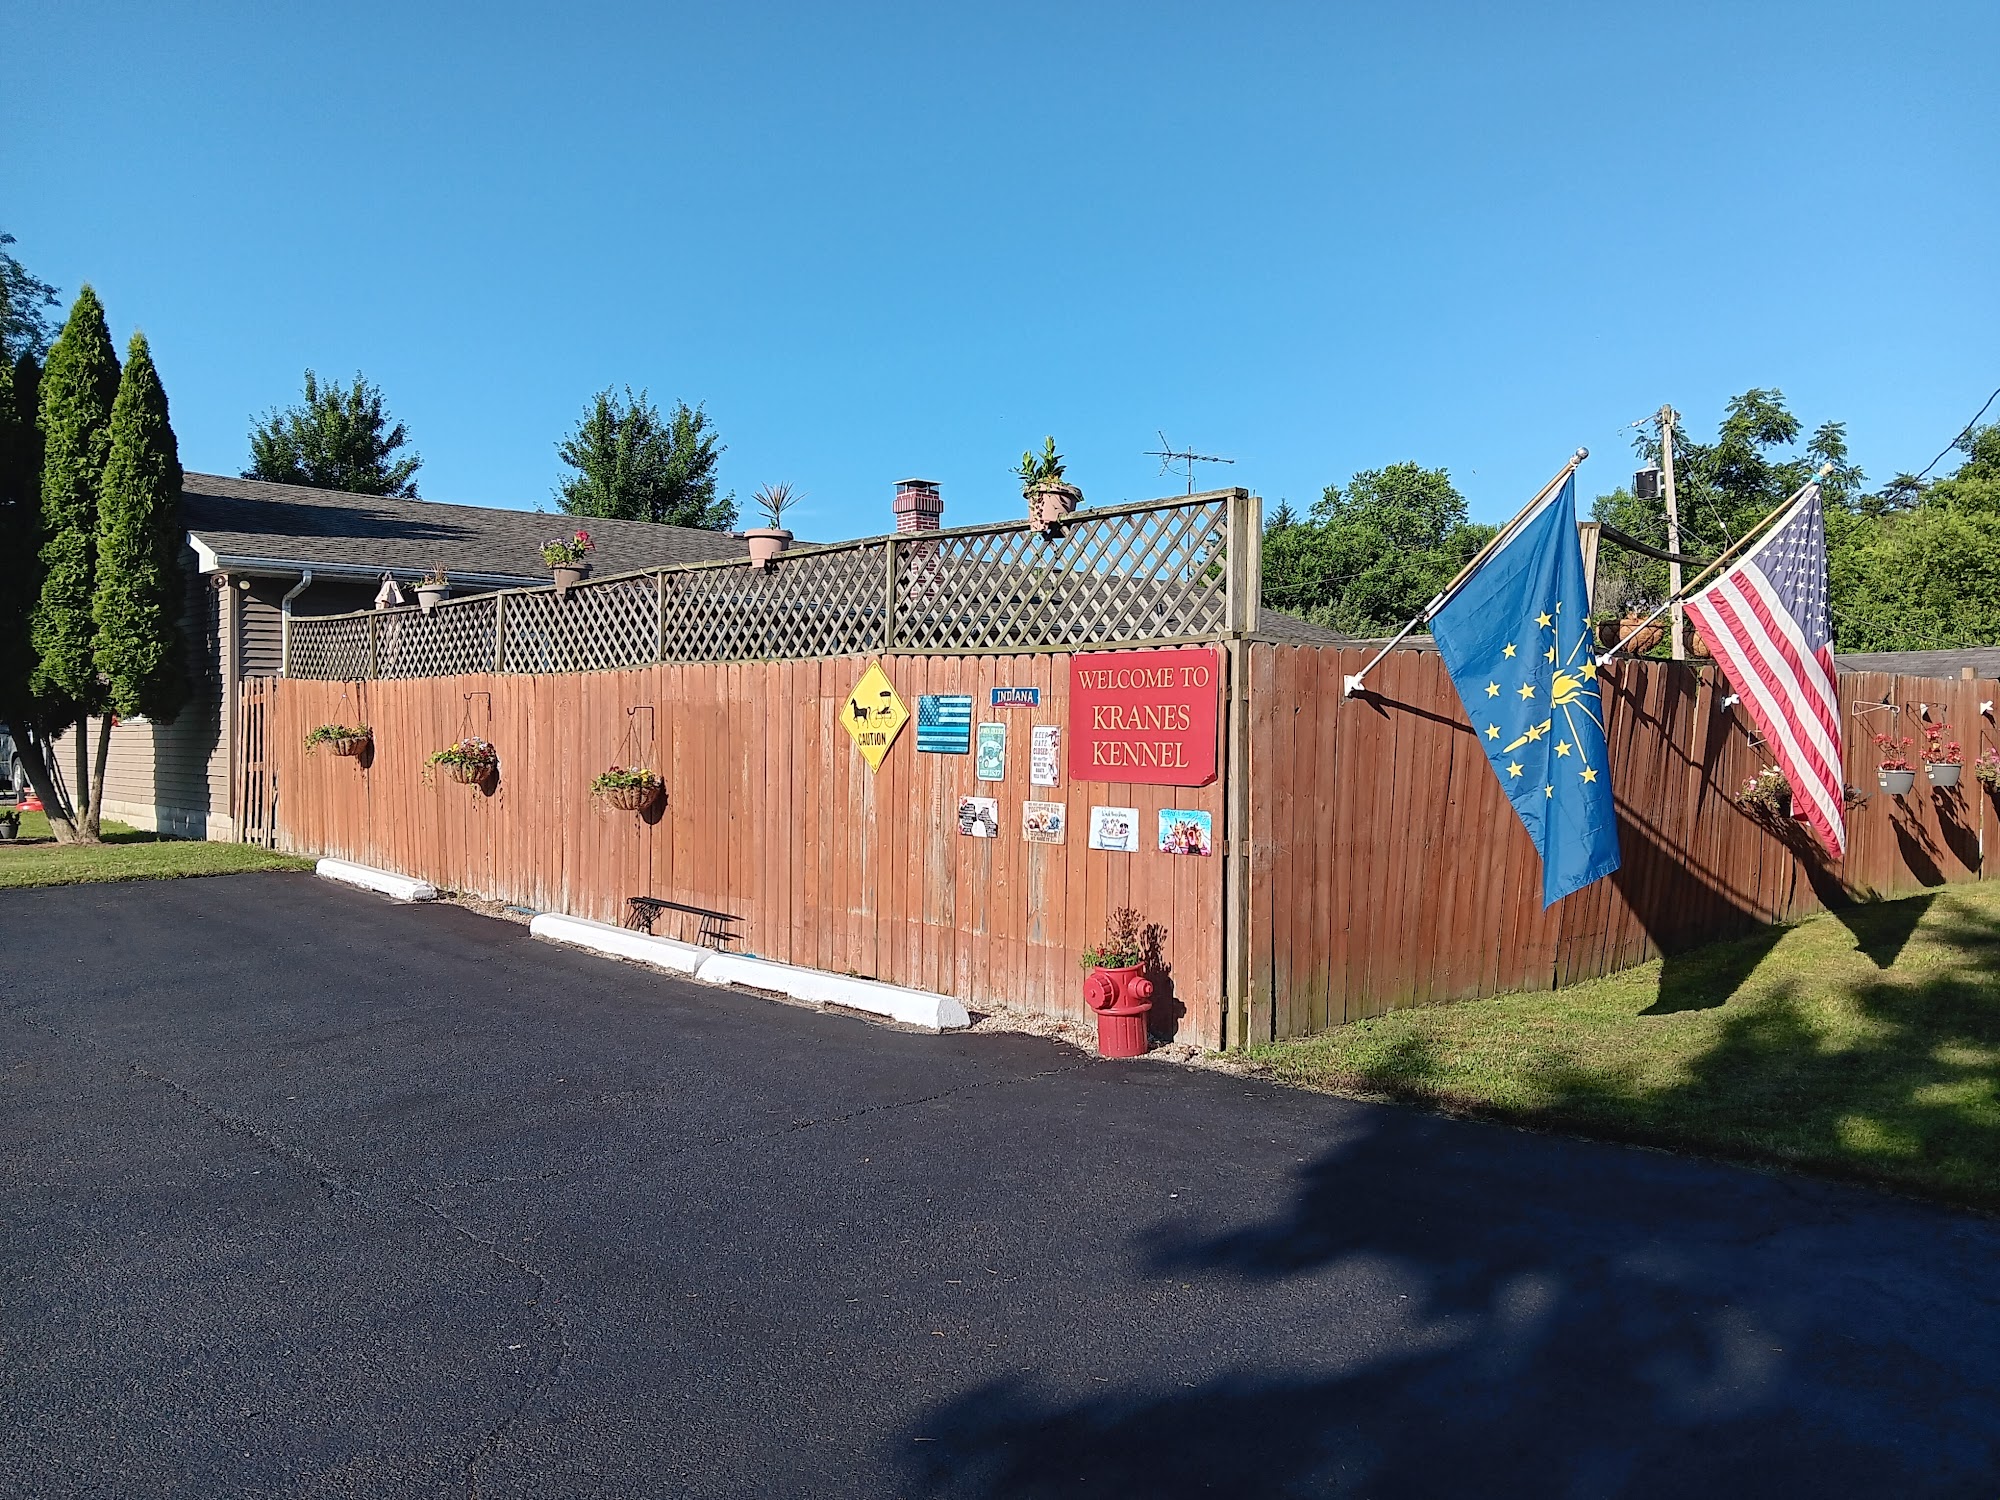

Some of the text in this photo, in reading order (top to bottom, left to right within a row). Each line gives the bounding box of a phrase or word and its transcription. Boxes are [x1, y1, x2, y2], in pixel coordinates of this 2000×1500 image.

[1078, 666, 1209, 690] WELCOME TO
[997, 688, 1034, 704] INDIANA
[1092, 704, 1190, 731] KRANES
[858, 732, 887, 746] CAUTION
[1092, 741, 1190, 768] KENNEL
